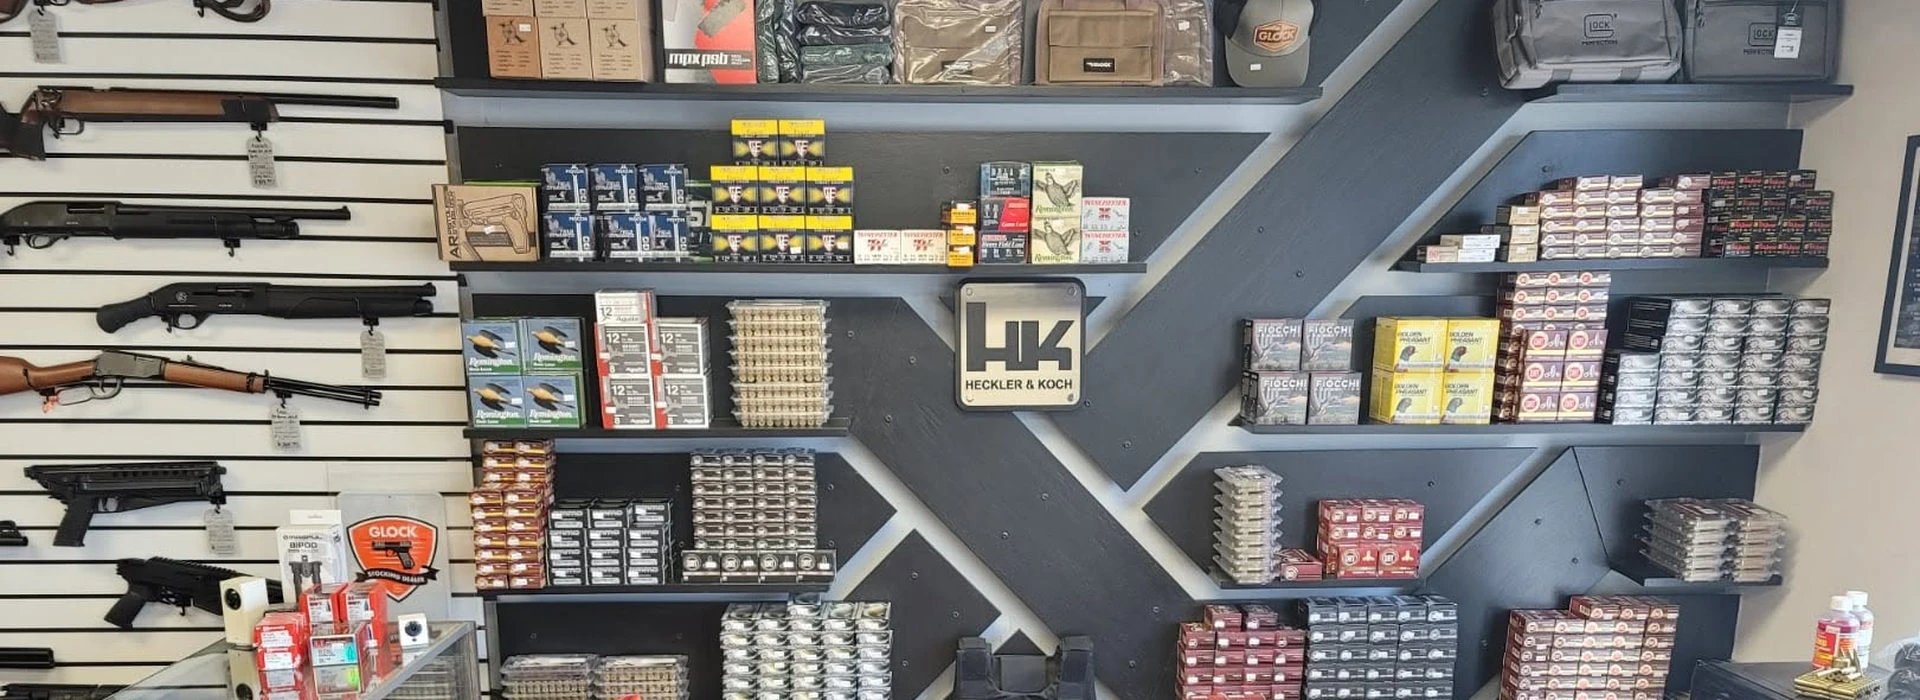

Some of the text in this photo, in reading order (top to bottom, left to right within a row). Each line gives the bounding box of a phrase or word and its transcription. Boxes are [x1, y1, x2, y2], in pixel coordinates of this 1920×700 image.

[1258, 30, 1295, 42] GLOCK
[668, 53, 700, 66] mpx
[1258, 326, 1301, 334] FIOCCHI
[1309, 326, 1352, 334] FIOCCHI
[606, 333, 620, 344] 12
[661, 333, 674, 344] 12
[966, 301, 1075, 372] HK
[966, 379, 1073, 390] HECKLER & KOCH
[1263, 379, 1307, 388] FIOCCHI
[1316, 379, 1360, 388] FIOCCHI
[611, 385, 625, 396] 12
[666, 385, 679, 396] 12
[368, 525, 418, 538] GLOCK
[289, 541, 318, 549] BIPOD
[367, 571, 401, 580] STOCKING
